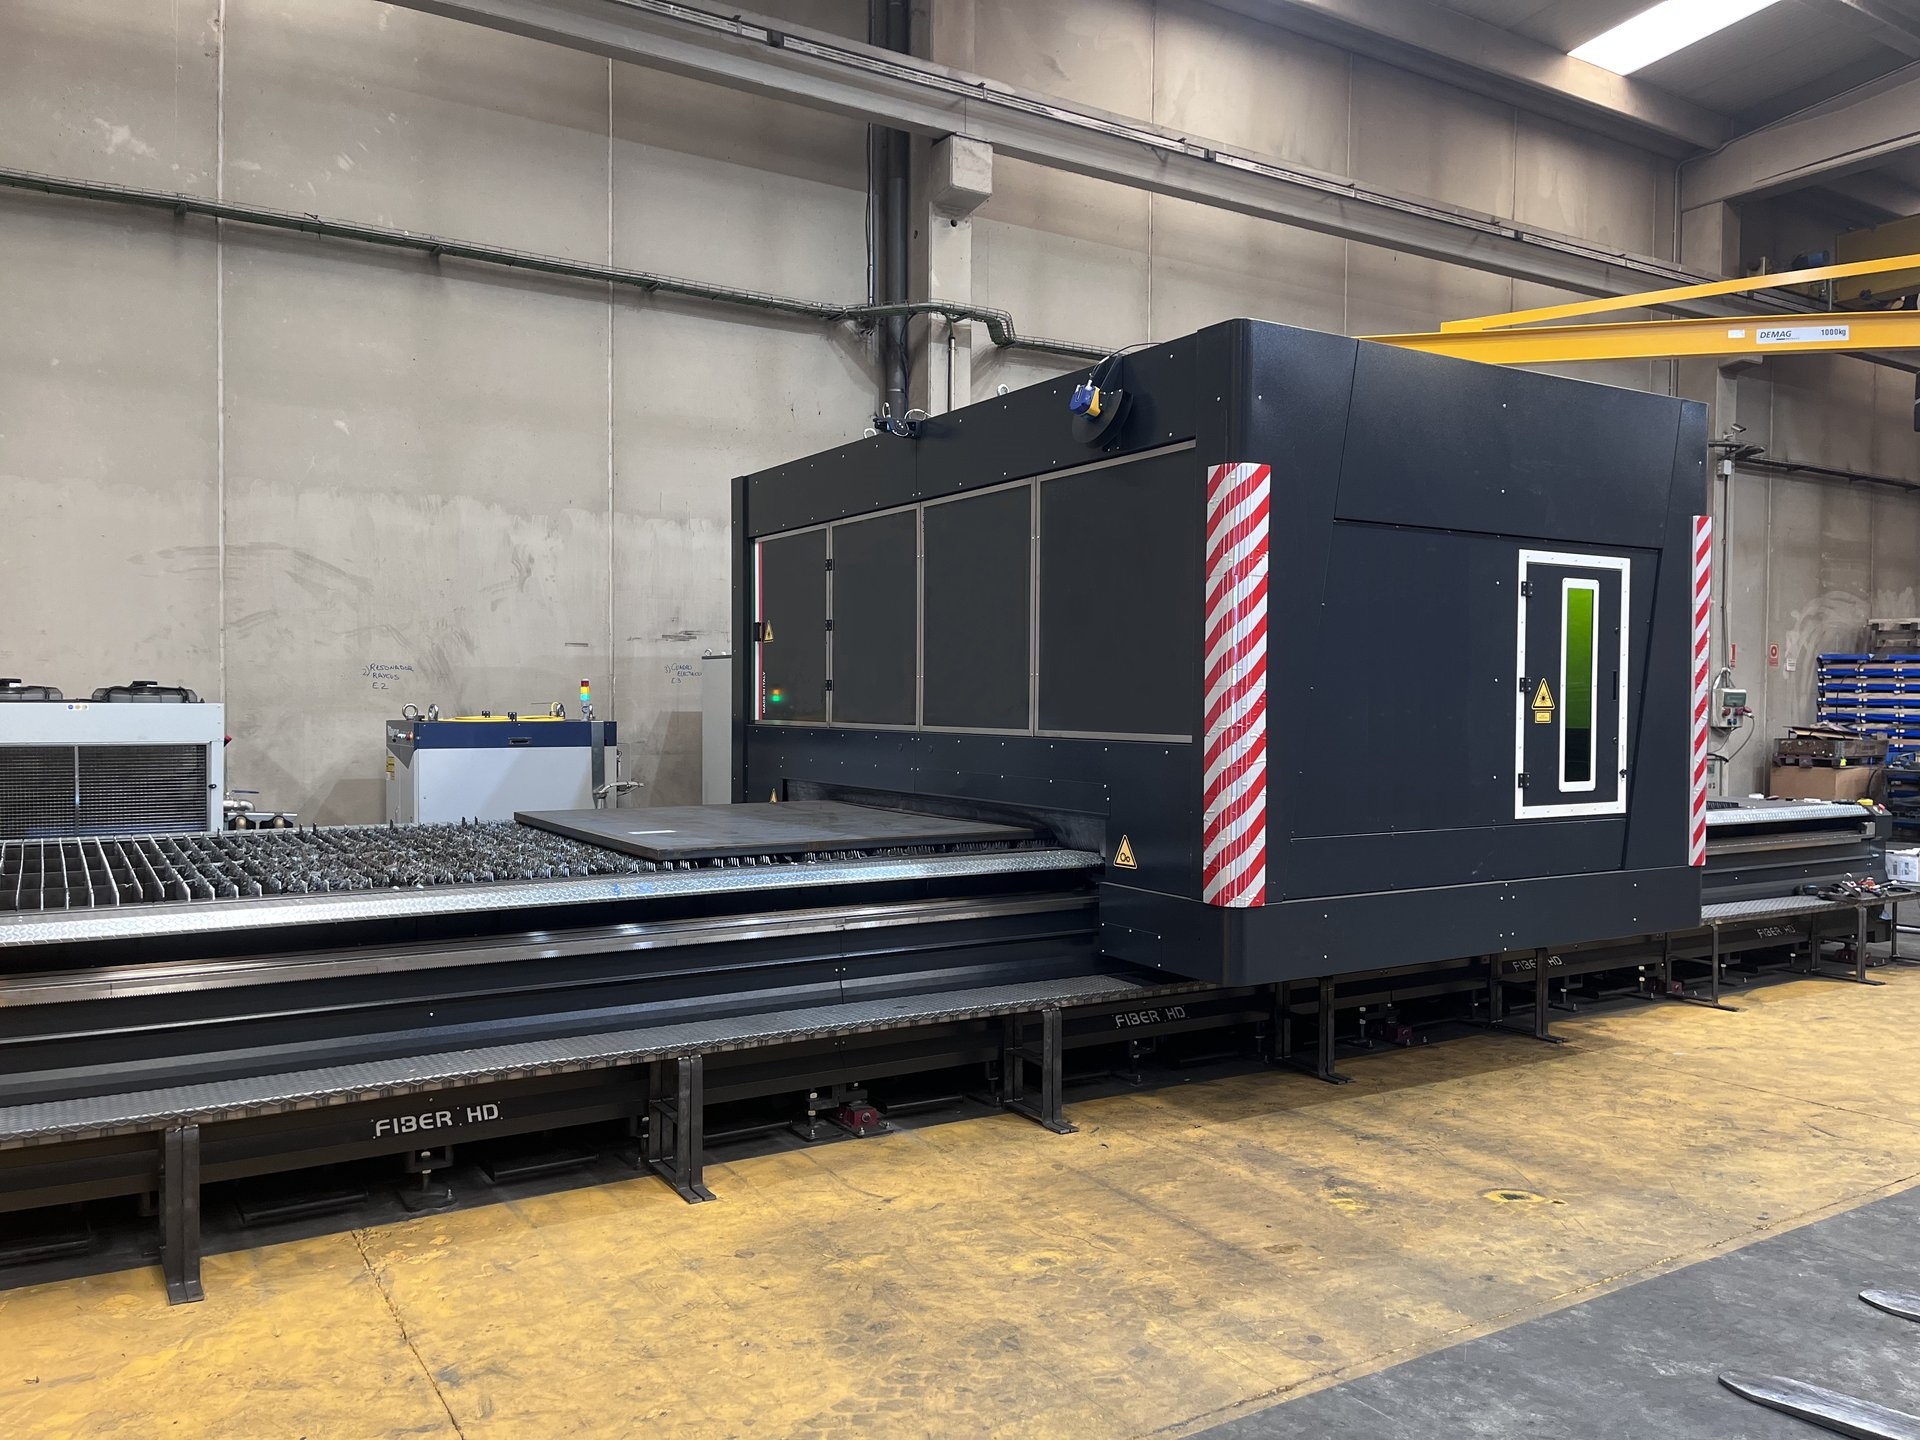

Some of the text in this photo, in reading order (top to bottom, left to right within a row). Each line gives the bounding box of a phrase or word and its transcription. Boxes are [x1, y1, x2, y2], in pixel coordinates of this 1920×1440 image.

[1760, 330, 1792, 339] DEMAG
[1821, 328, 1847, 336] 1000kg
[1512, 955, 1562, 972] FIBE HD
[1115, 1006, 1186, 1027] FIBER HD
[375, 1103, 499, 1137] FIBER HD
